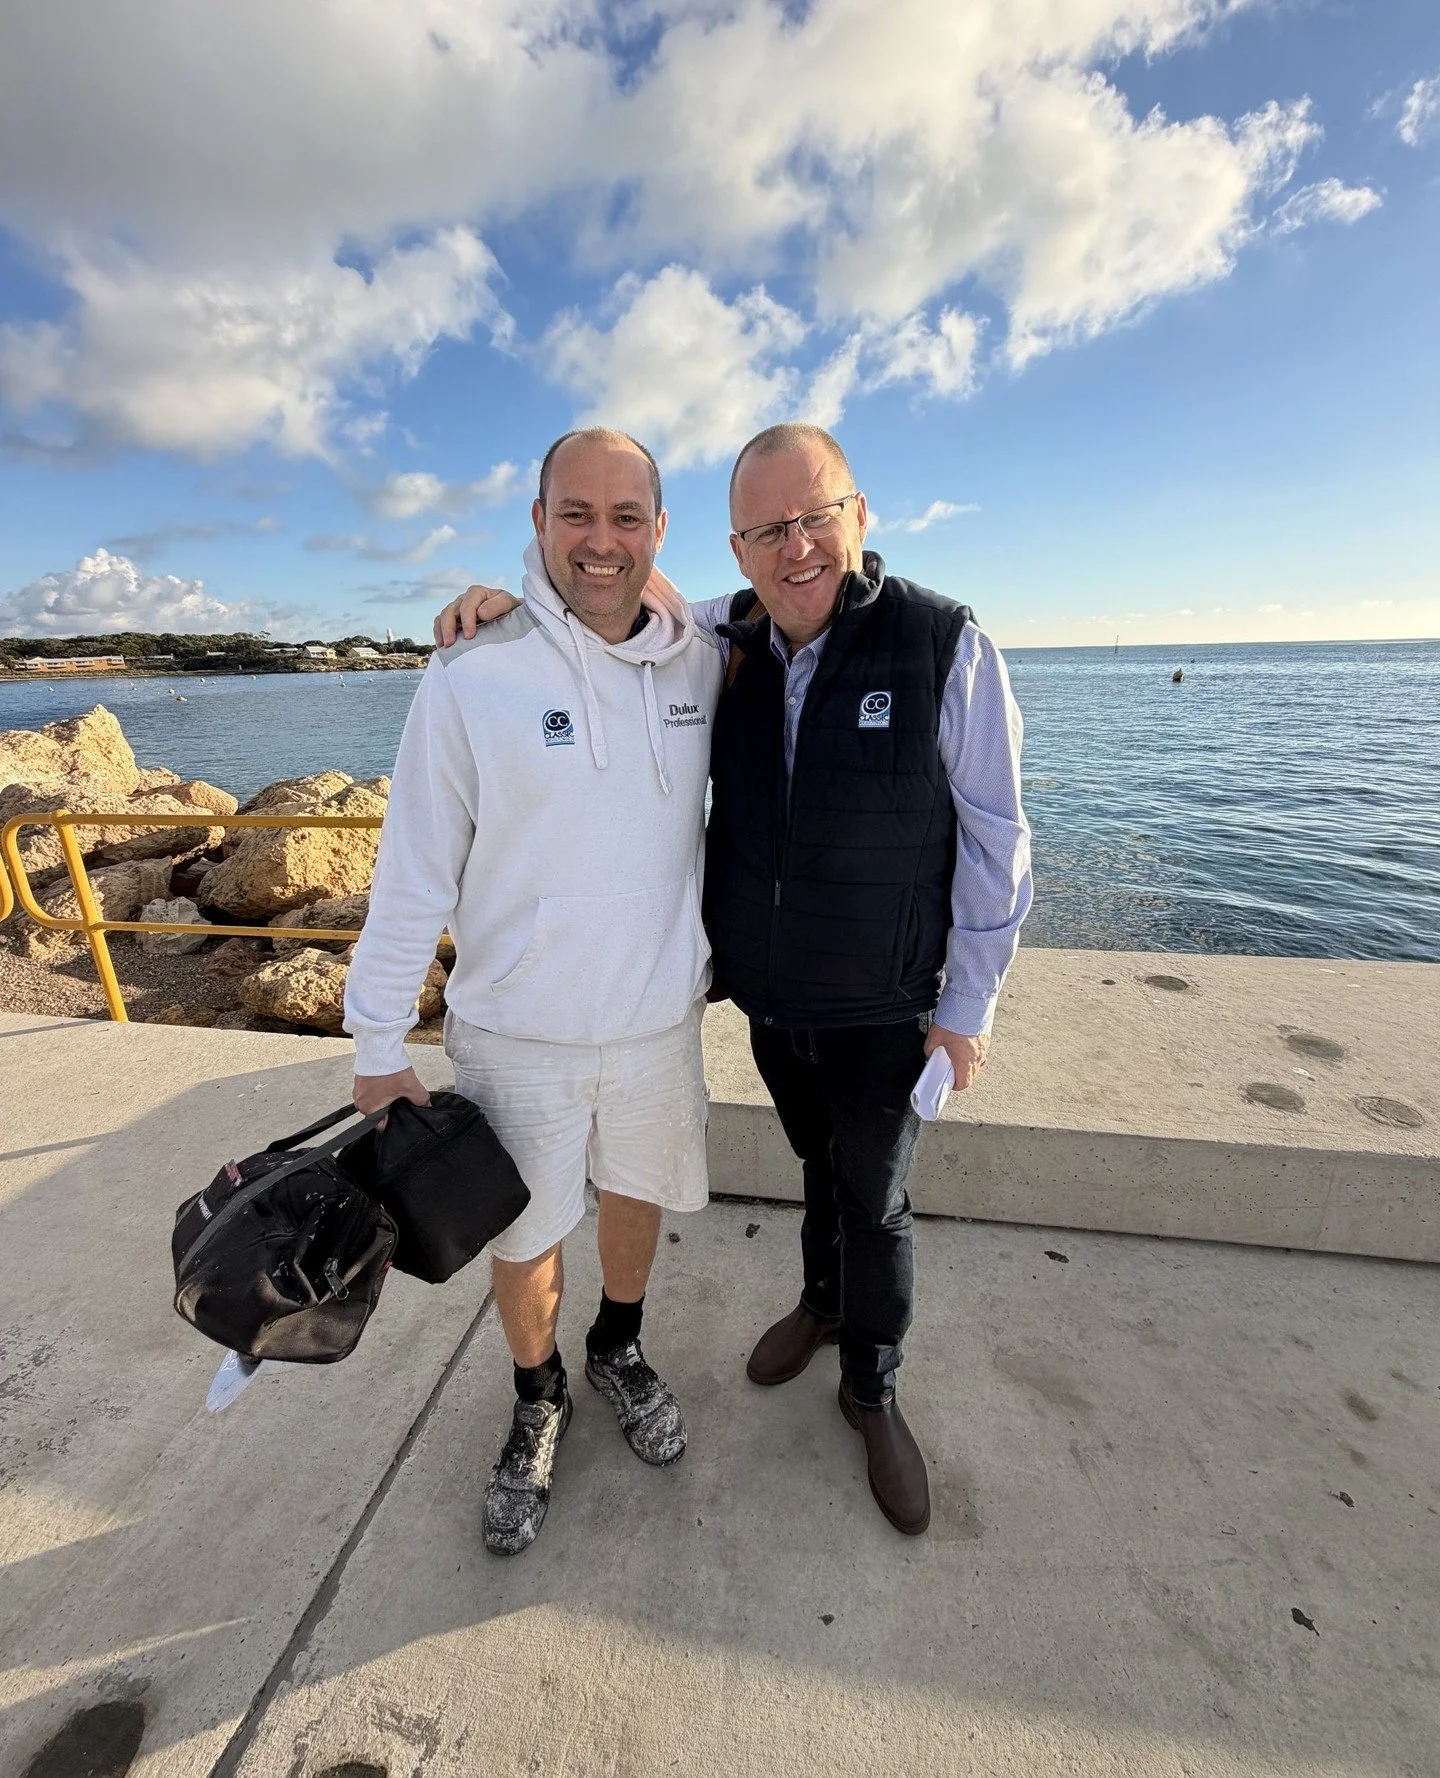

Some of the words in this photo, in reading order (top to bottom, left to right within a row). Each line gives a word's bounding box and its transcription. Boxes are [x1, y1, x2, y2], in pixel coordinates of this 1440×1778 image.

[669, 703, 699, 716] Dulux
[865, 698, 886, 710] CC
[547, 715, 568, 727] CC
[663, 715, 707, 728] Professional
